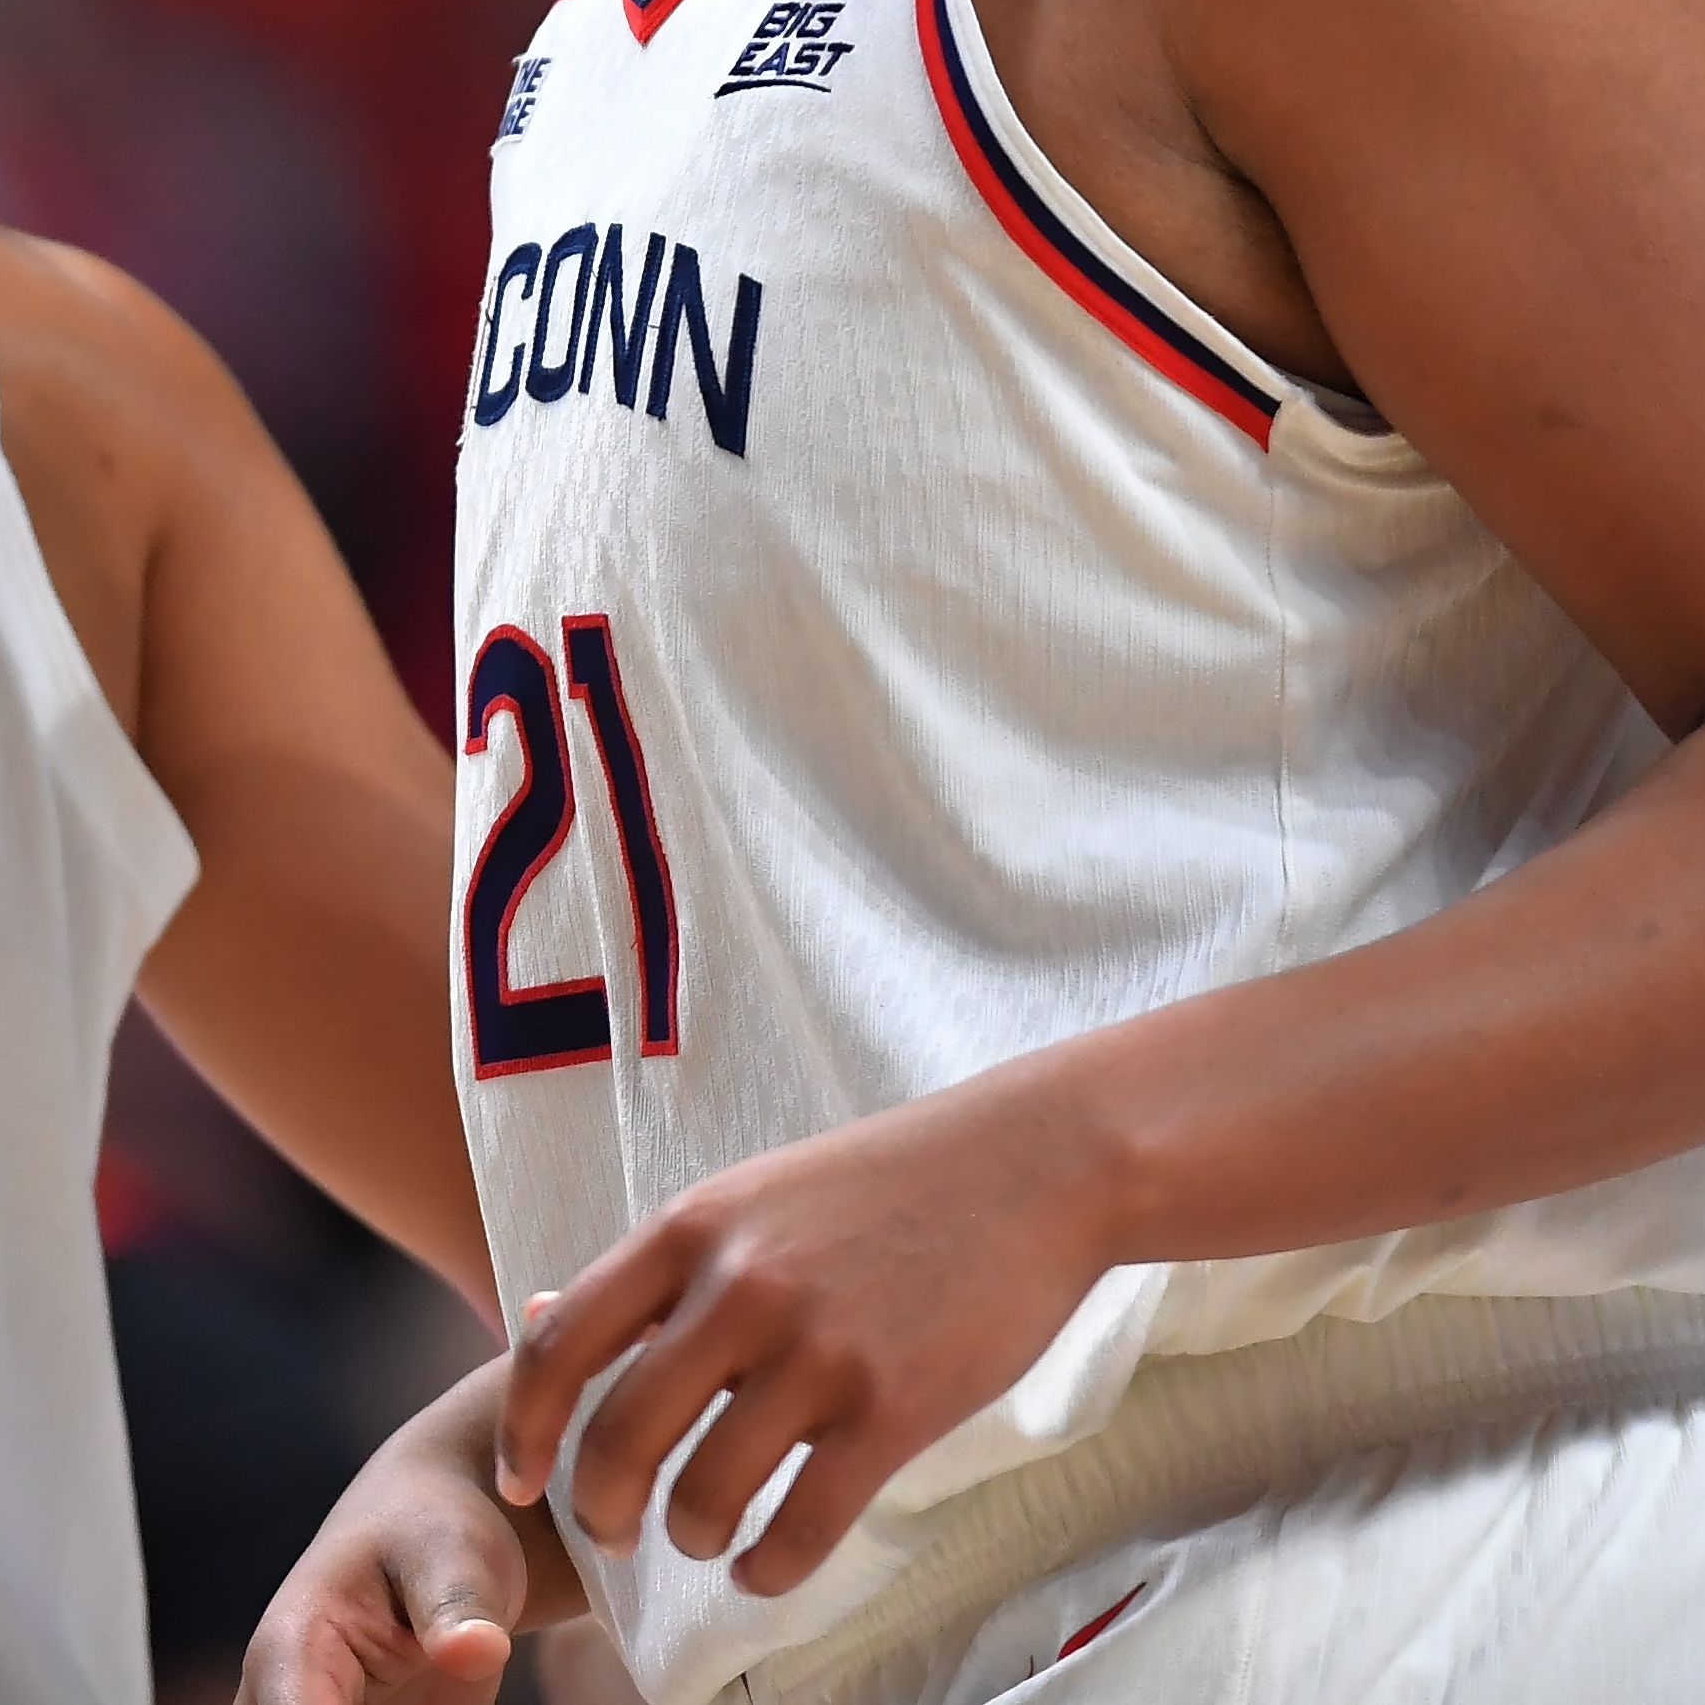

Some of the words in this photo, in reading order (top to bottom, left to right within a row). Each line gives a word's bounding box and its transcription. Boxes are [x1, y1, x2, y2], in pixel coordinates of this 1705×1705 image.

[752, 1, 846, 39] BIG
[515, 56, 552, 93] HE
[727, 41, 855, 77] EAST
[474, 221, 762, 460] CONN
[462, 612, 680, 1081] 21
